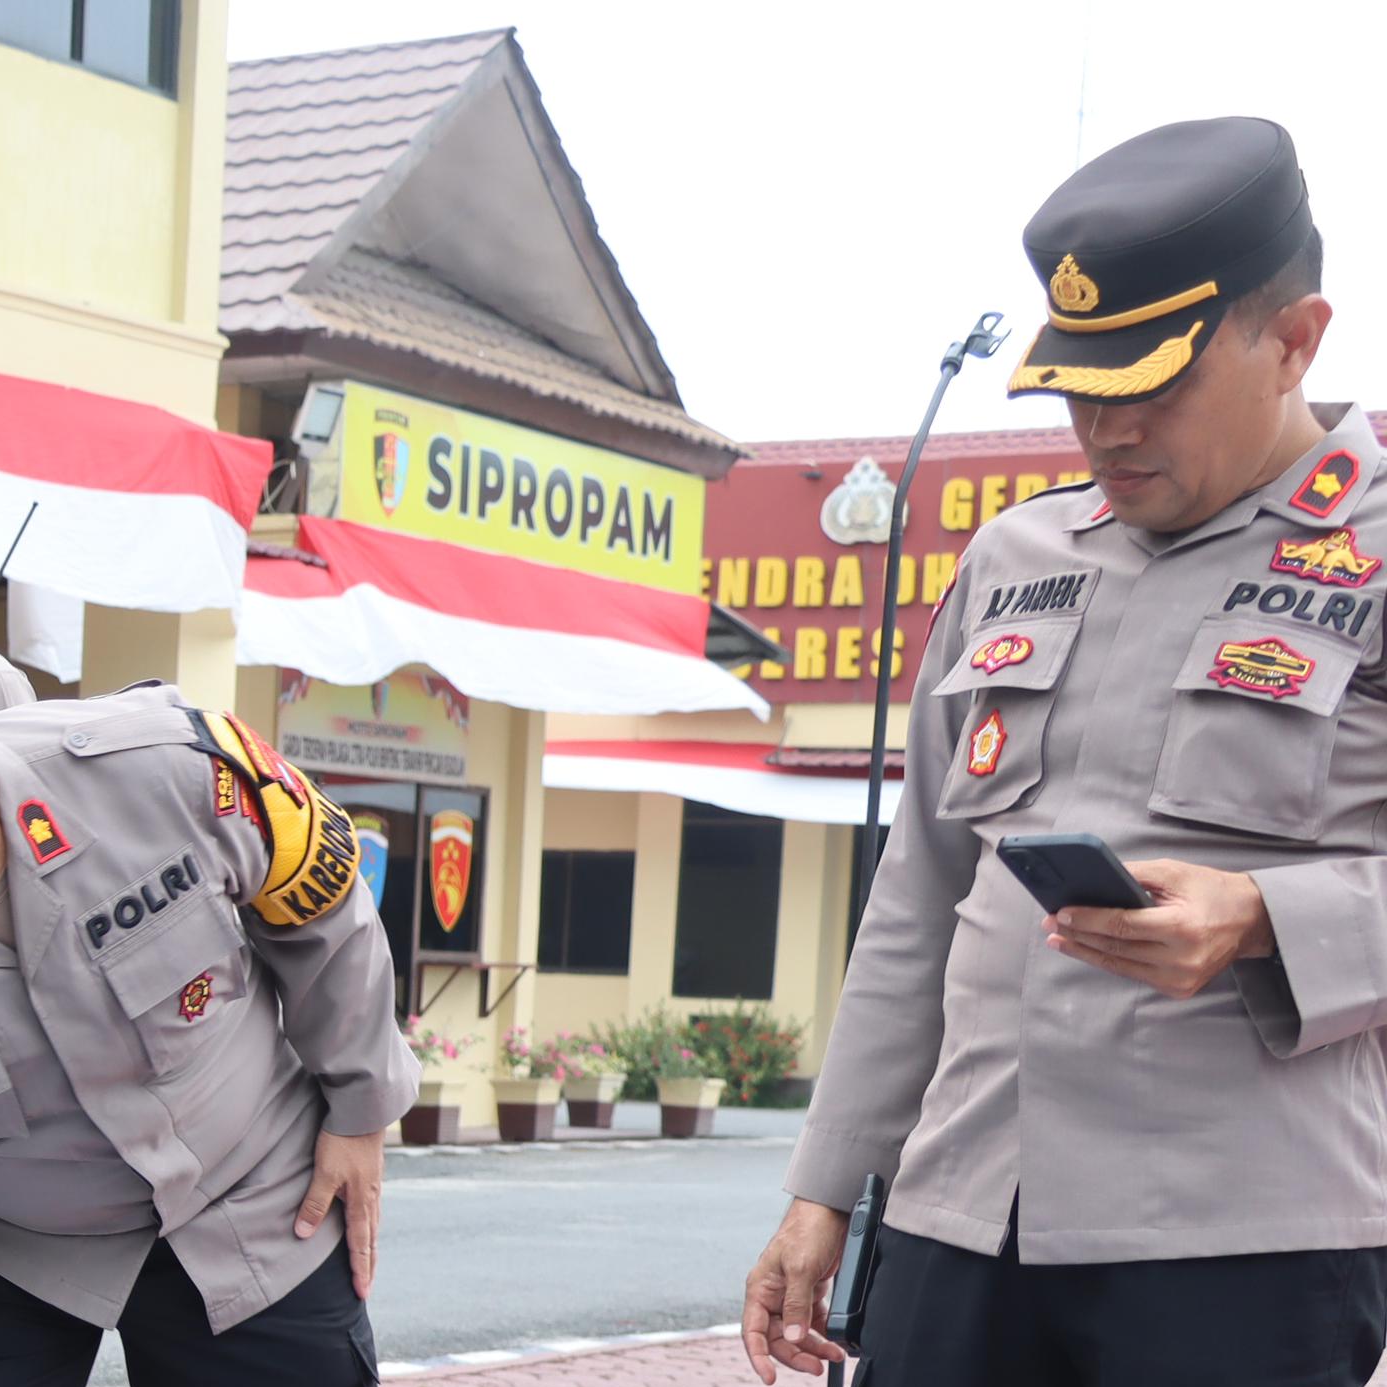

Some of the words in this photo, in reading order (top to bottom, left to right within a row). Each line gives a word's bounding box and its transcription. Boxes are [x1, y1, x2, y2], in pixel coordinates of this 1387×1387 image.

[427, 436, 674, 562] SIPROPAM
[1224, 582, 1373, 638] POLRI
[86, 852, 200, 949] POLRI
